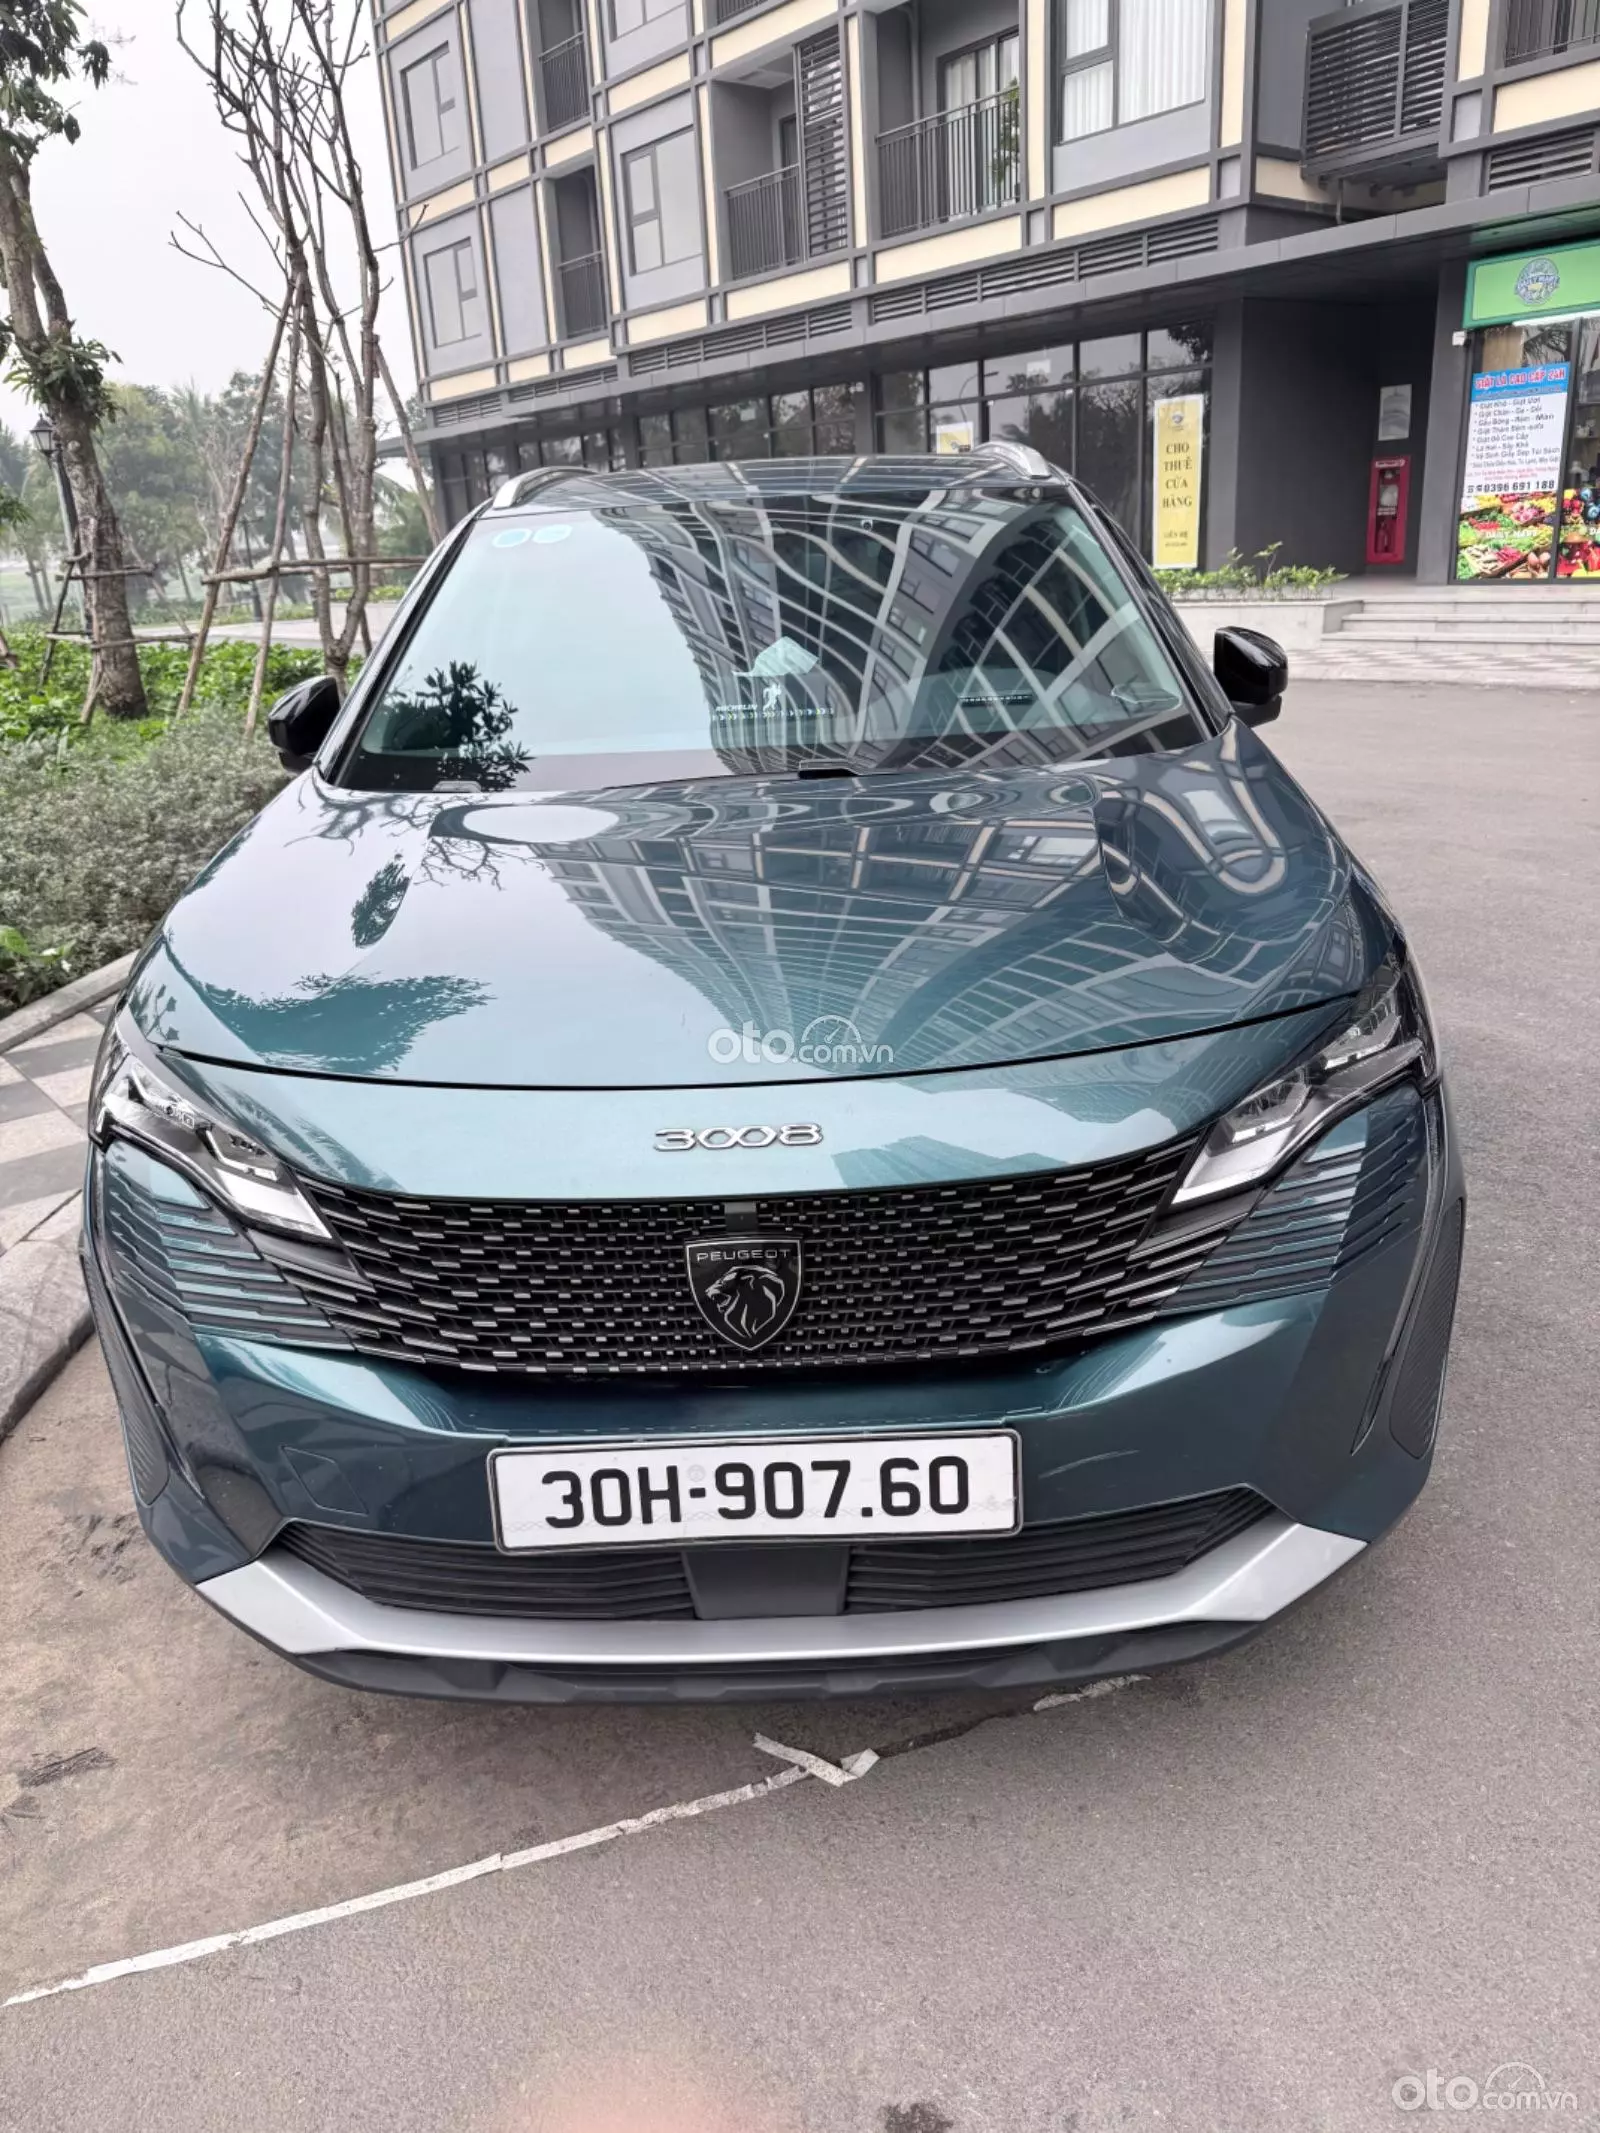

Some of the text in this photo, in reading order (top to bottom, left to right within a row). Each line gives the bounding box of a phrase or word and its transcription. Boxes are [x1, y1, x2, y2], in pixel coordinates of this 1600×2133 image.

[1165, 442, 1190, 454] CHO
[1163, 456, 1192, 471] THUÊ
[1165, 475, 1188, 489] CỬA
[1513, 481, 1531, 491] 691
[1162, 494, 1192, 508] HÀNG
[654, 1123, 823, 1151] 3008
[696, 1249, 790, 1262] PEUGEOT
[541, 1456, 969, 1529] 30H-907.60
